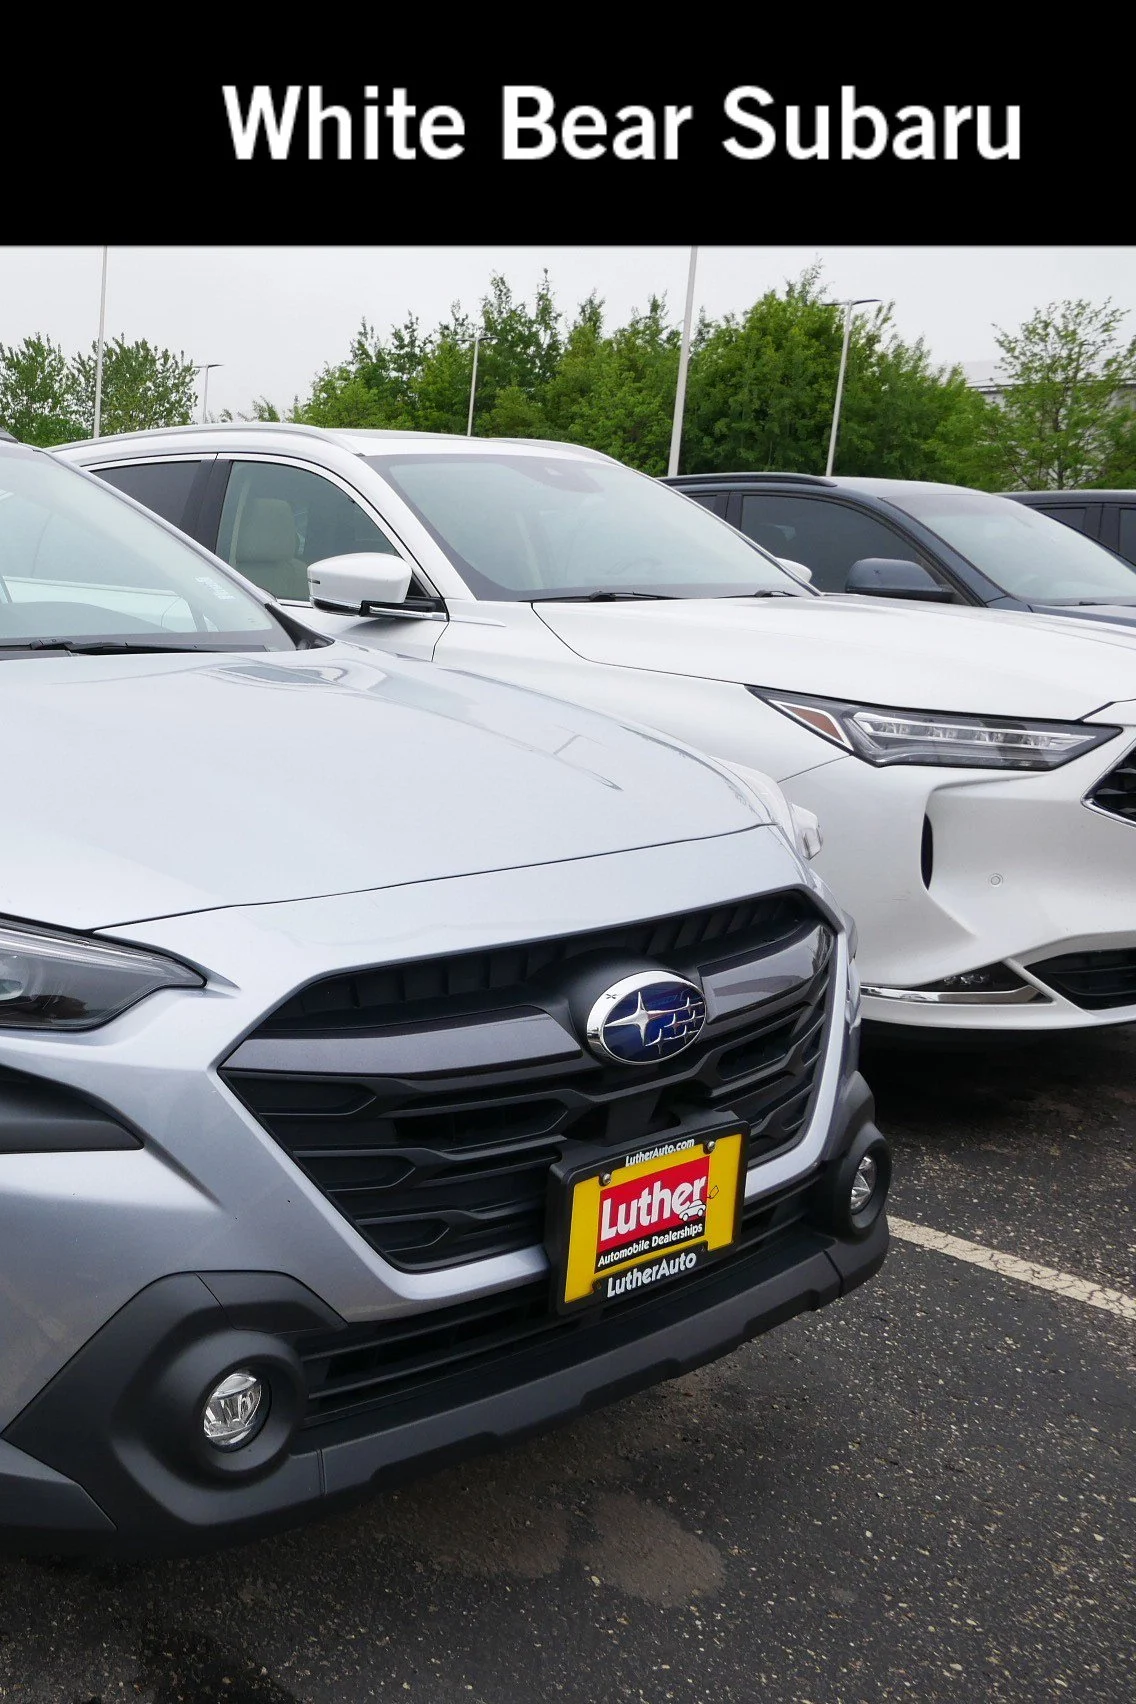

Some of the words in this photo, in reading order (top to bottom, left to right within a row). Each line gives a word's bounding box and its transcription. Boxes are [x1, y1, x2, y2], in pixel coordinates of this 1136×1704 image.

[625, 1138, 695, 1167] LutherAuto.com
[600, 1176, 707, 1242] Luther
[598, 1239, 650, 1267] Automobile
[651, 1223, 703, 1248] Dealerships
[607, 1252, 697, 1298] LutherAuto
